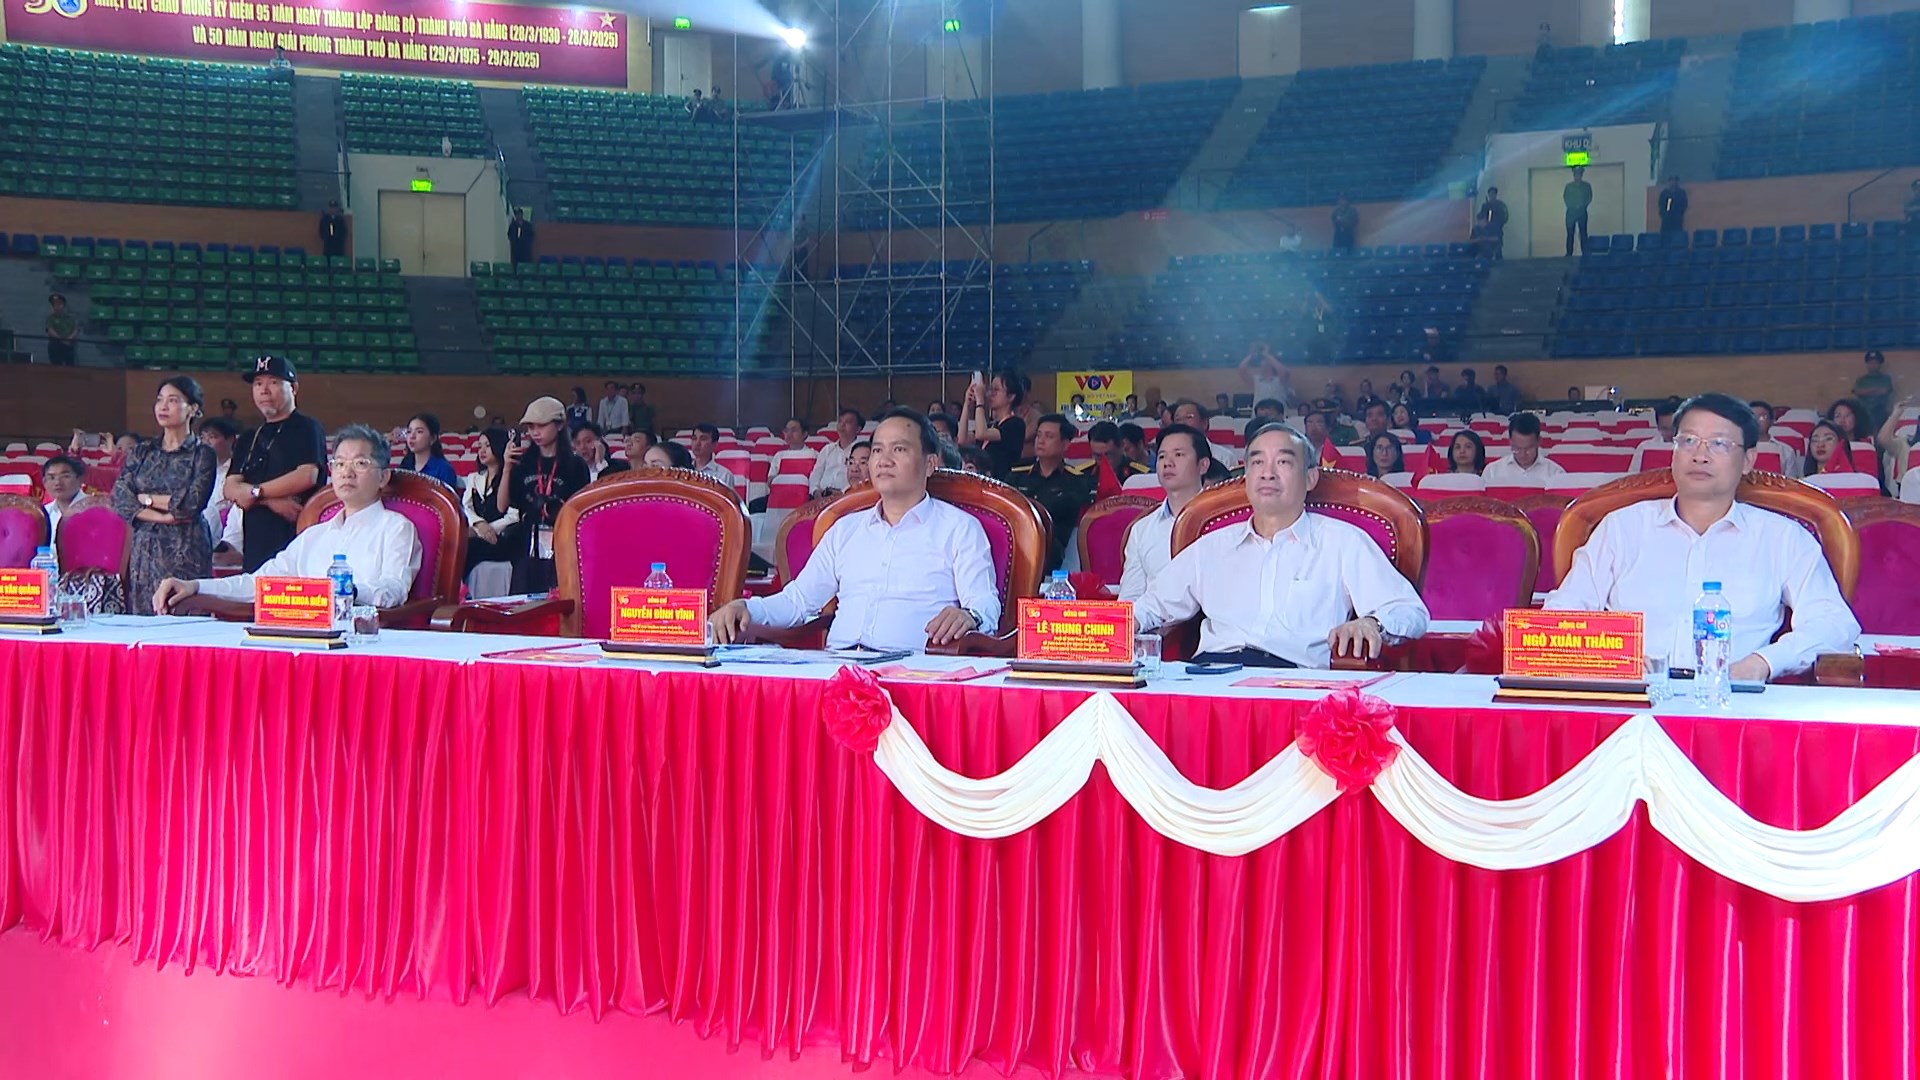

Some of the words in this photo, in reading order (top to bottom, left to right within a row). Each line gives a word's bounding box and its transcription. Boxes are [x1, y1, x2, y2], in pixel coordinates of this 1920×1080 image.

[256, 4, 270, 21] 95
[272, 3, 294, 24] NĂM
[296, 5, 321, 26] NGÀY
[322, 8, 354, 29] THÀNH
[356, 9, 373, 33] LẬP
[375, 10, 400, 32] ĐẢNG
[402, 14, 415, 37] BỘ
[417, 16, 447, 36] THÀNH
[449, 16, 467, 38] PHỐ
[469, 19, 482, 39] ĐÀ
[510, 24, 561, 45] (28/3/1930
[567, 28, 619, 48] 28/3/2025)
[192, 23, 207, 45] VÀ
[209, 27, 223, 45] 50
[225, 26, 247, 48] NĂM
[249, 28, 275, 50] NGÀY
[277, 30, 298, 51] GIẢI
[300, 33, 332, 54] PHÓNG
[333, 35, 365, 56] THÀNH
[366, 36, 386, 58] PHỐ
[388, 40, 401, 59] ĐÀ
[429, 44, 480, 65] (29/3/1975
[487, 49, 540, 69] 29/3/2025)
[1074, 375, 1115, 391] VOV
[621, 605, 652, 619] NGUYỄN
[654, 606, 673, 620] ĐÌNH
[675, 608, 694, 620] VĨNH
[1036, 620, 1048, 633] LÊ
[1050, 622, 1081, 635] TRUNG
[1084, 623, 1114, 635] CHINH
[1522, 632, 1547, 647] NGÔ
[1549, 633, 1582, 648] XUÂN
[1584, 631, 1624, 649] THẮNG
